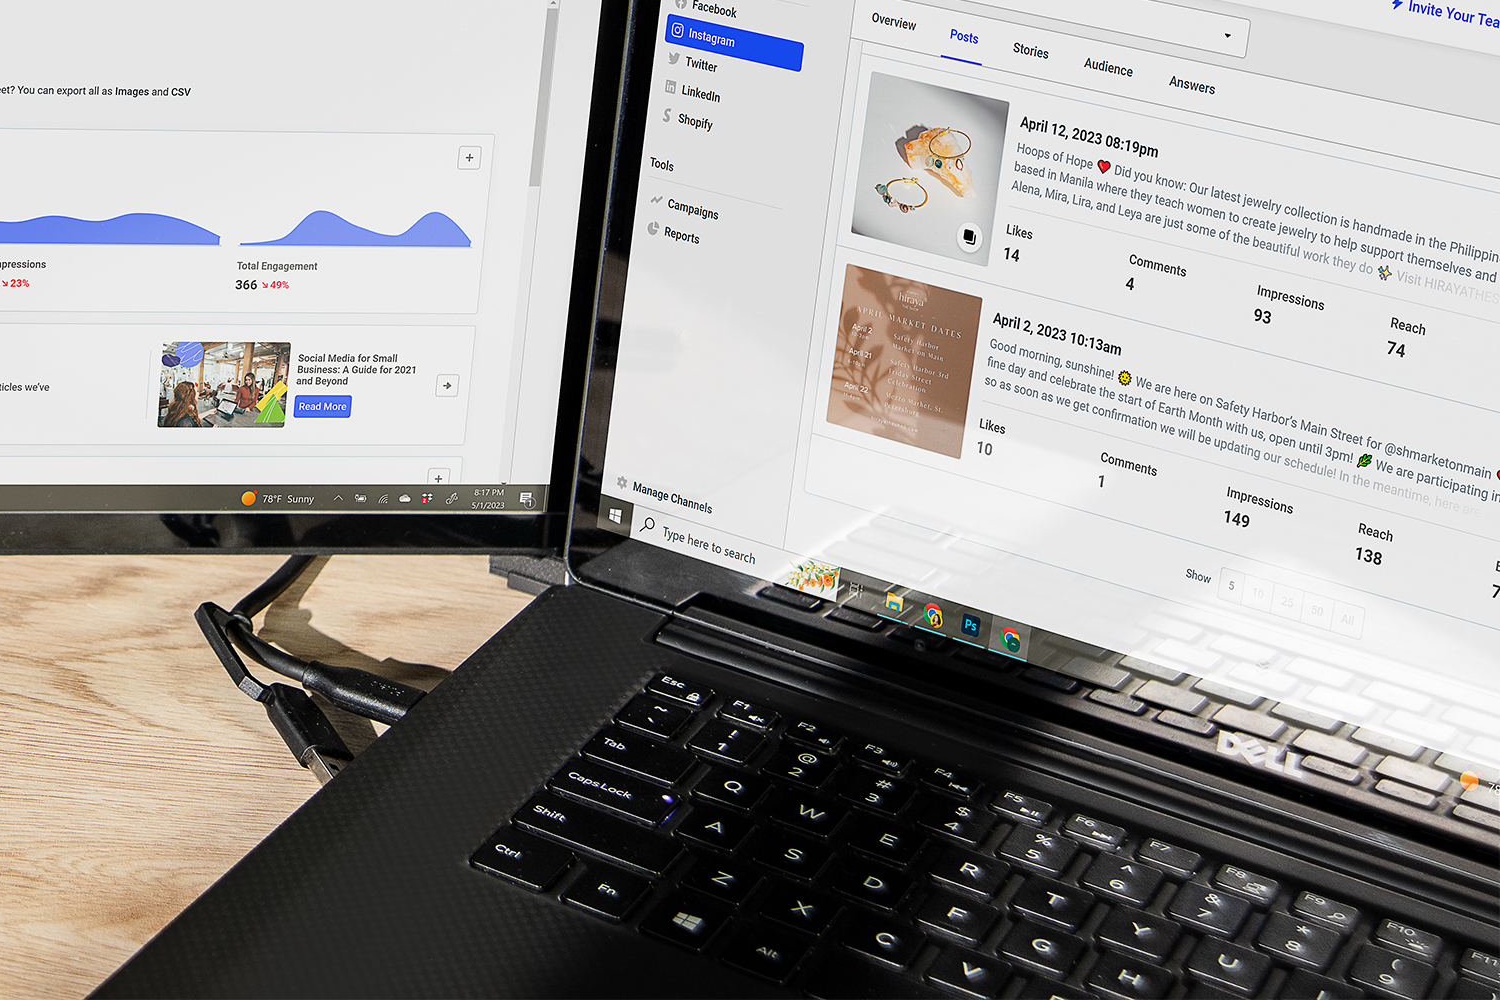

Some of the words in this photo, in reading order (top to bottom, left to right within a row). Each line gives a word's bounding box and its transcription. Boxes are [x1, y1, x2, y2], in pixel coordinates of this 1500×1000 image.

[692, 0, 737, 19] Facebook
[1408, 0, 1443, 18] Invite
[1446, 6, 1476, 24] Your
[1477, 12, 1500, 29] Tea
[871, 12, 917, 31] Overview
[688, 27, 736, 48] Instagram
[949, 28, 979, 45] Posts
[1012, 42, 1050, 60] Stories
[685, 55, 718, 73] Twitter
[1083, 57, 1134, 78] Audience
[681, 84, 721, 103] LinkedIn
[1168, 75, 1216, 95] Answers
[677, 113, 714, 133] Shopify
[1019, 116, 1049, 134] April
[1051, 123, 1069, 141] 12,
[1071, 127, 1103, 145] 2023
[1105, 134, 1159, 159] 08:19pm
[649, 156, 675, 172] Tools
[667, 198, 719, 221] Campaigns
[664, 226, 700, 245] Reports
[1006, 223, 1033, 240] Likes
[1004, 247, 1020, 263] 14
[236, 261, 260, 271] Total
[261, 261, 318, 273] Engagement
[1129, 254, 1187, 278] Comments
[10, 278, 30, 288] 23%
[235, 279, 258, 291] 366
[269, 280, 290, 290] 49%
[1125, 277, 1135, 291] 4
[1257, 284, 1325, 311] Impressions
[857, 306, 883, 319] APRIL
[889, 314, 926, 330] MARKET
[931, 325, 962, 340] DATES
[1253, 308, 1272, 325] 93
[992, 312, 1021, 330] April
[1022, 319, 1034, 336] 2,
[1036, 323, 1067, 342] 2023
[1070, 332, 1122, 357] 10:13am
[1390, 316, 1426, 336] Reach
[1387, 340, 1406, 358] 74
[298, 353, 326, 363] Social
[327, 353, 356, 363] Media
[357, 353, 371, 363] for
[372, 353, 398, 363] Small
[297, 364, 341, 374] Business:
[342, 365, 350, 374] A
[351, 365, 378, 374] Guide
[379, 364, 393, 374] for
[394, 365, 416, 375] 2021
[295, 376, 314, 385] and
[315, 376, 349, 387] Beyond
[298, 402, 322, 411] Read
[323, 402, 347, 411] More
[979, 417, 1006, 435] Likes
[977, 441, 993, 456] 10
[1100, 451, 1158, 477] Comments
[1098, 475, 1105, 488] 1
[262, 494, 282, 504] 78°F
[287, 494, 315, 506] Sunny
[473, 488, 490, 496] 8:17
[491, 488, 505, 496] PM
[632, 481, 669, 502] Manage
[670, 493, 713, 515] Channels
[1226, 486, 1294, 515] Impressions
[471, 501, 505, 510] 5/1/2023
[1224, 510, 1250, 528] 149
[1358, 522, 1394, 543] Reach
[1355, 547, 1383, 566] 138
[661, 676, 686, 689] Esc
[733, 700, 751, 710] F1
[797, 722, 817, 733] F2
[604, 737, 626, 751] Tab
[865, 744, 884, 756] F3
[1217, 730, 1303, 779] DELL
[934, 767, 953, 778] F4
[533, 804, 567, 823] Shift
[495, 844, 522, 860] Ctrl
[597, 883, 618, 897] Fn
[755, 946, 778, 959] Alt
